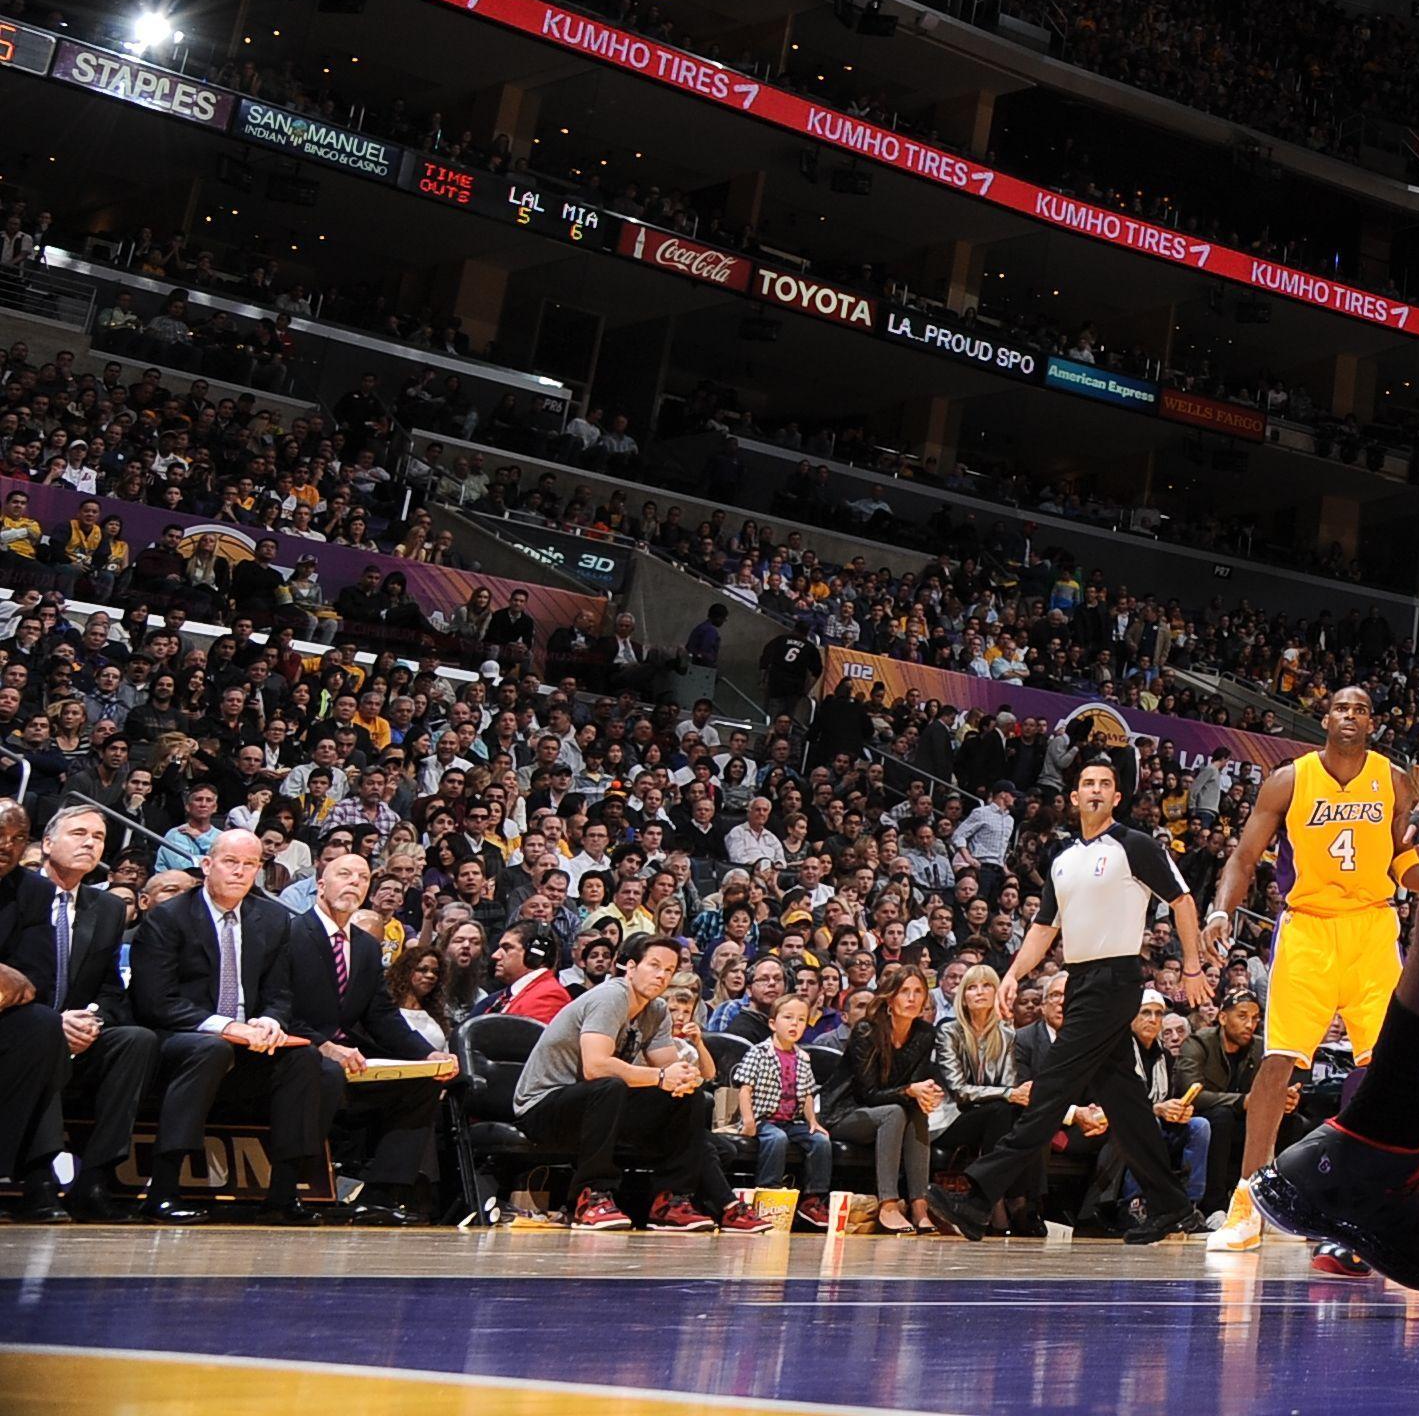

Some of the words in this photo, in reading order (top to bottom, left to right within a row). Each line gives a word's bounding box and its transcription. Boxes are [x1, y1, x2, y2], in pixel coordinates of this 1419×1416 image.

[542, 8, 650, 69] KUMHO
[657, 49, 729, 99] TIRES
[72, 52, 216, 122] STAPLES
[244, 124, 287, 145] INDIAN
[304, 142, 339, 162] BINGO
[349, 156, 388, 177] CASINO
[247, 104, 291, 134] SAN
[304, 122, 390, 165] MANUEL
[807, 107, 899, 161] KUMHO
[905, 143, 967, 186] TIRES
[424, 161, 475, 190] TIME
[509, 185, 545, 213] LAL
[562, 200, 599, 229] MIA
[517, 207, 531, 225] 5
[570, 224, 583, 241] 6
[1035, 191, 1120, 239] KUMHO
[1124, 221, 1185, 261] TIRES
[758, 268, 872, 328] TOYOTA
[1251, 261, 1330, 303] KUMHO
[1333, 286, 1387, 322] TIRES
[1049, 363, 1107, 392] American
[1107, 379, 1155, 404] Express
[1163, 395, 1213, 421] WELLS
[1215, 409, 1264, 434] FARGO
[577, 553, 615, 573] 3D
[784, 647, 800, 663] 6
[843, 662, 874, 680] 102
[1305, 800, 1384, 827] LAKERS
[1328, 828, 1356, 871] 4
